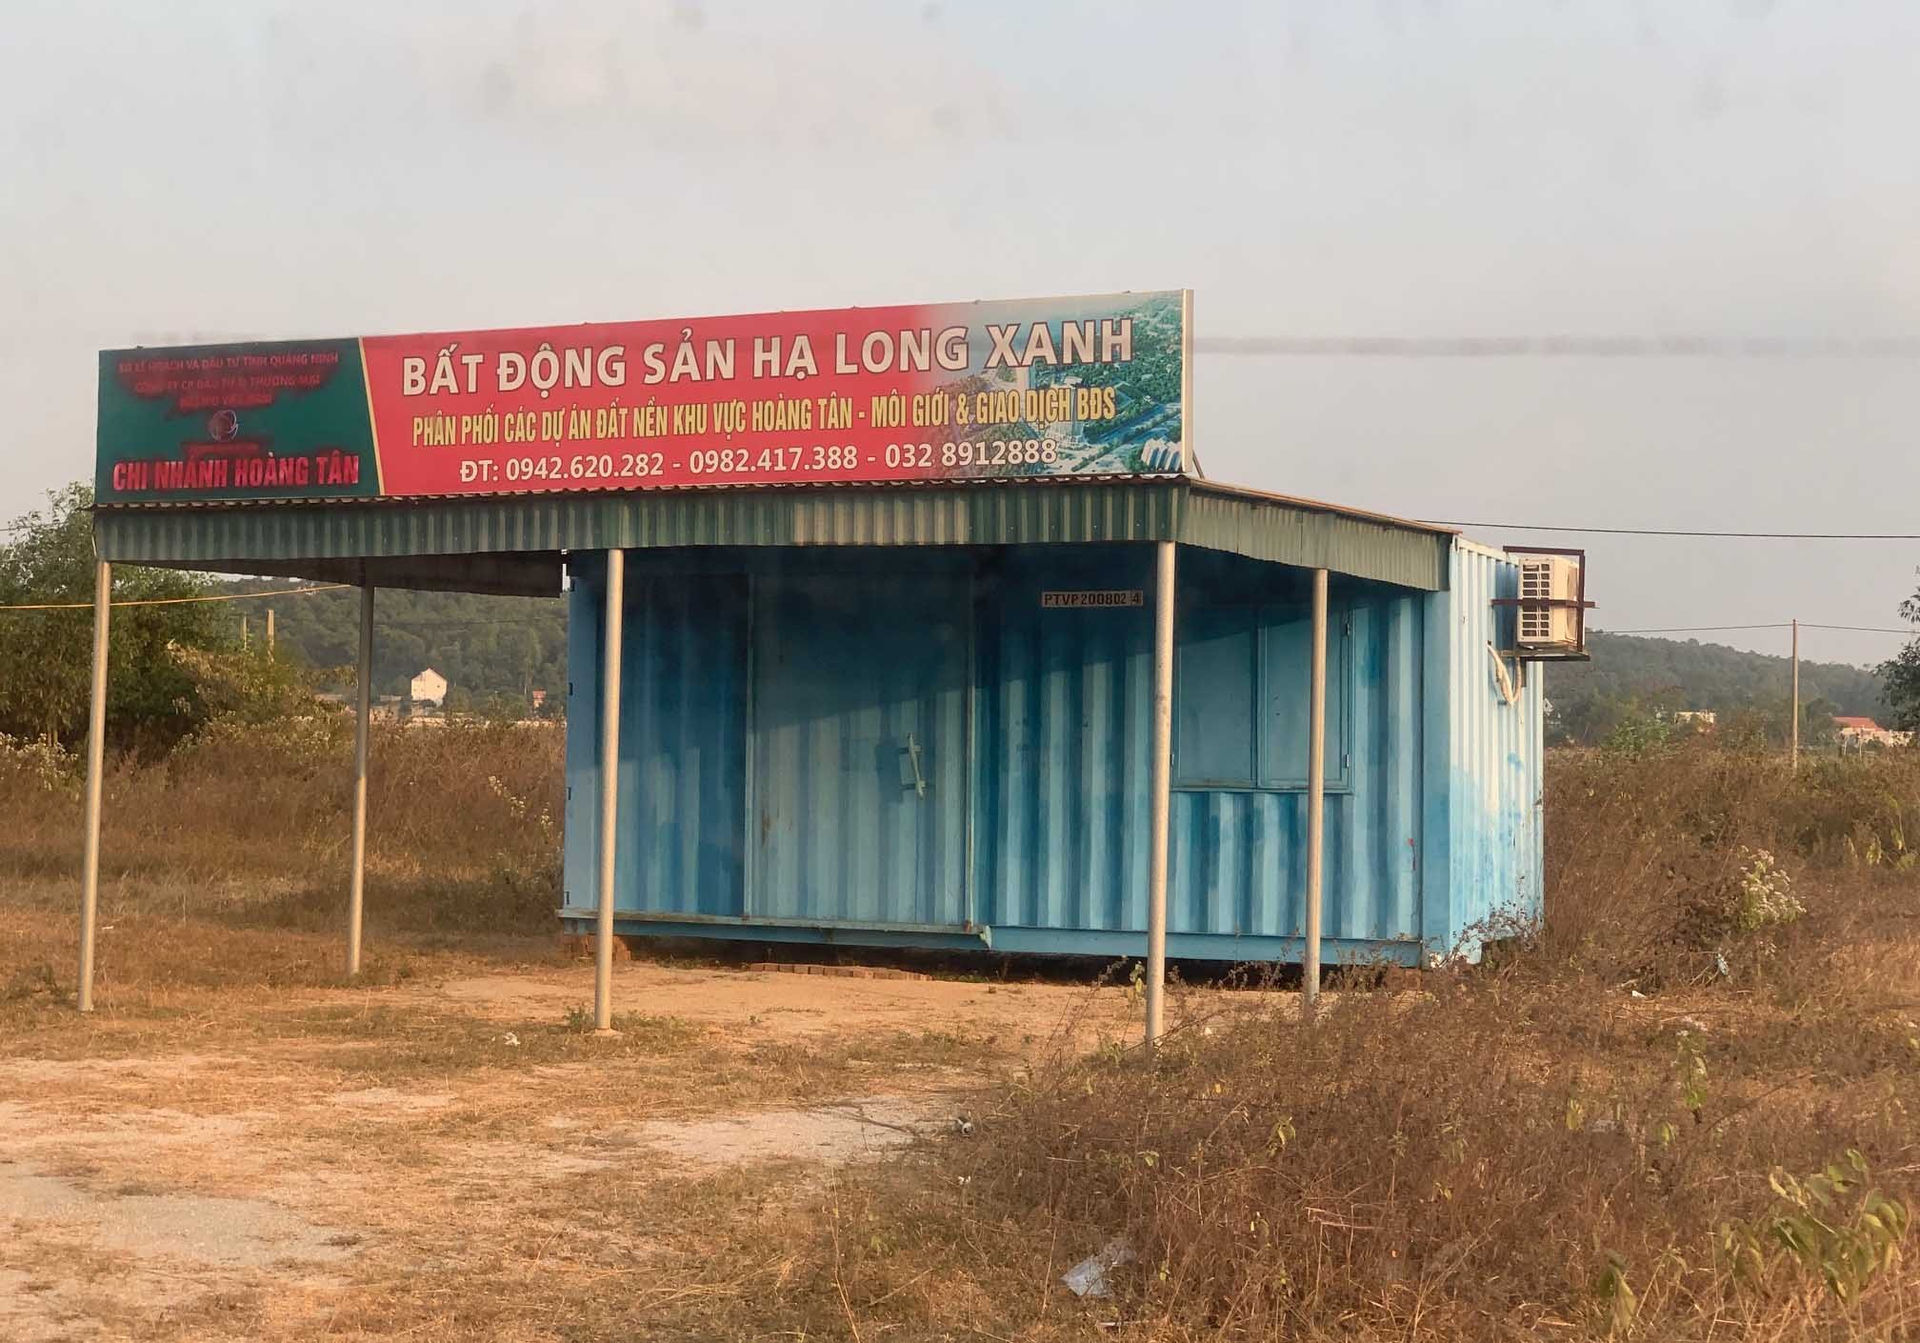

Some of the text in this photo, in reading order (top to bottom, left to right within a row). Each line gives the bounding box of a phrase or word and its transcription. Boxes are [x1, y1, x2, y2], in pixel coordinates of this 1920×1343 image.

[402, 318, 1134, 399] BẤT ĐỘNG SẢN HẠ LONG XANH
[412, 410, 456, 446] PHÂN
[461, 403, 499, 444] PHỐI
[504, 406, 536, 442] CÁC
[541, 407, 566, 447] DỰ
[568, 403, 591, 440] ÁN
[596, 397, 628, 438] ĐẤT
[633, 396, 668, 437] NỀN
[673, 403, 707, 435] KHU
[713, 399, 746, 441] VỰC
[752, 392, 812, 432] HOÀNG
[817, 391, 853, 430] TÂN
[871, 389, 906, 428] MÔI
[912, 382, 951, 427] GIỚI
[955, 396, 970, 425] &
[975, 390, 1020, 425] GIAO
[1025, 387, 1072, 430] DỊCH
[1076, 386, 1116, 420] BĐS
[113, 460, 148, 490] CHI
[234, 451, 309, 487] HOÀNG
[316, 449, 359, 485] TÂN
[459, 459, 499, 483] ĐT:
[505, 453, 664, 481] 0942.620.282
[689, 444, 858, 474] 0982.417.388
[884, 443, 933, 469] 032
[940, 438, 1058, 466] 8912888
